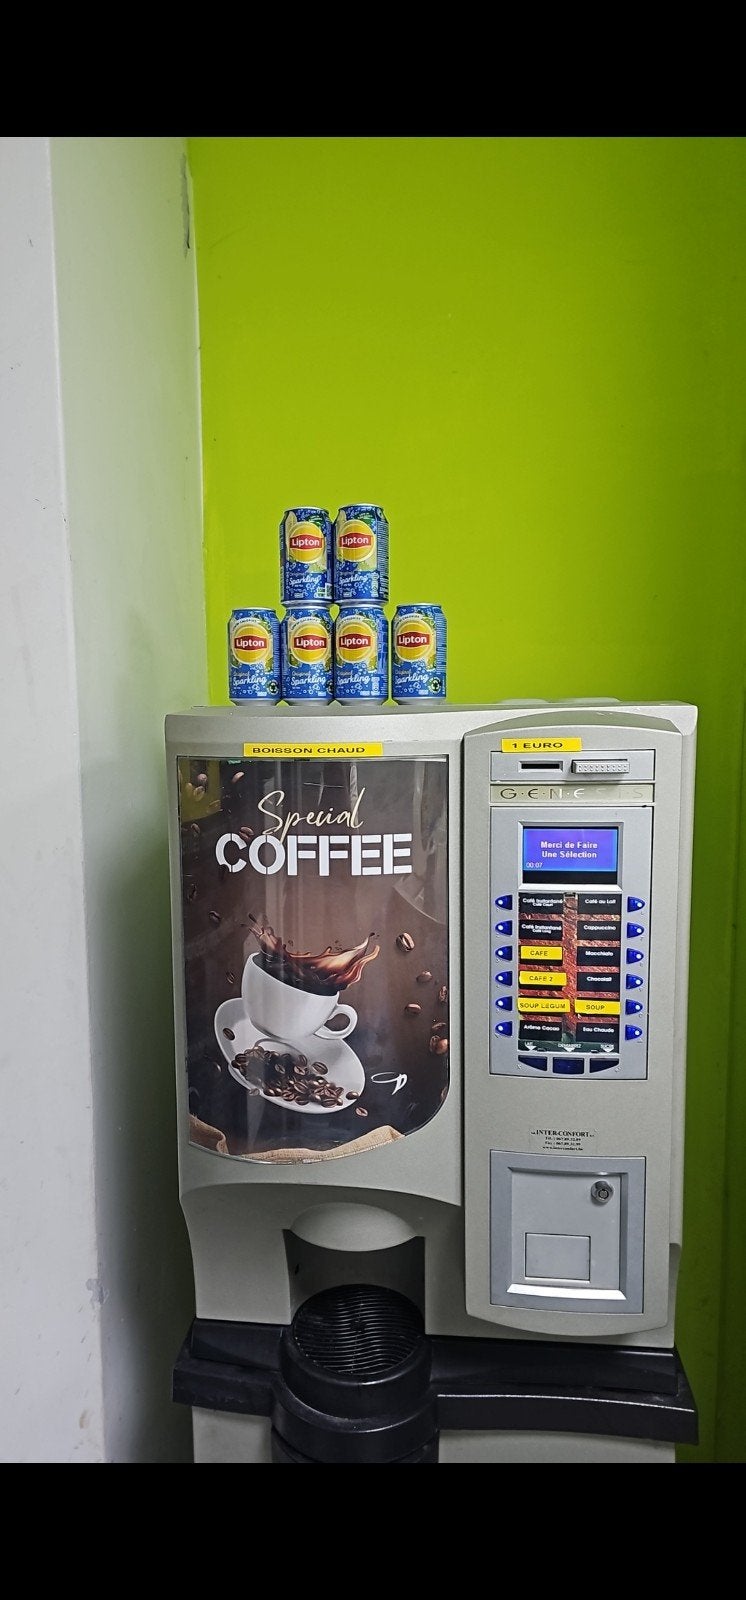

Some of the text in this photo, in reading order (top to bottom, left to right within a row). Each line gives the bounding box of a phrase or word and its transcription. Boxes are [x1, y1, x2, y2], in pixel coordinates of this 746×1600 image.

[291, 539, 320, 547] Lipton
[341, 536, 369, 546] Lipton
[289, 574, 321, 585] Sparkling
[339, 573, 369, 585] Sparkling
[236, 639, 265, 648] Lipton
[296, 638, 325, 648] Lipton
[340, 637, 369, 647] Lipton
[398, 635, 427, 645] Lipton
[232, 675, 267, 686] Sparkling
[291, 675, 326, 686] Sparkling
[336, 673, 371, 686] Sparkling
[394, 671, 430, 685] Sparkling
[256, 789, 366, 845] Special
[540, 841, 598, 849] Merci de Faire
[215, 833, 413, 877] COFFEE
[559, 850, 597, 859] Sélection
